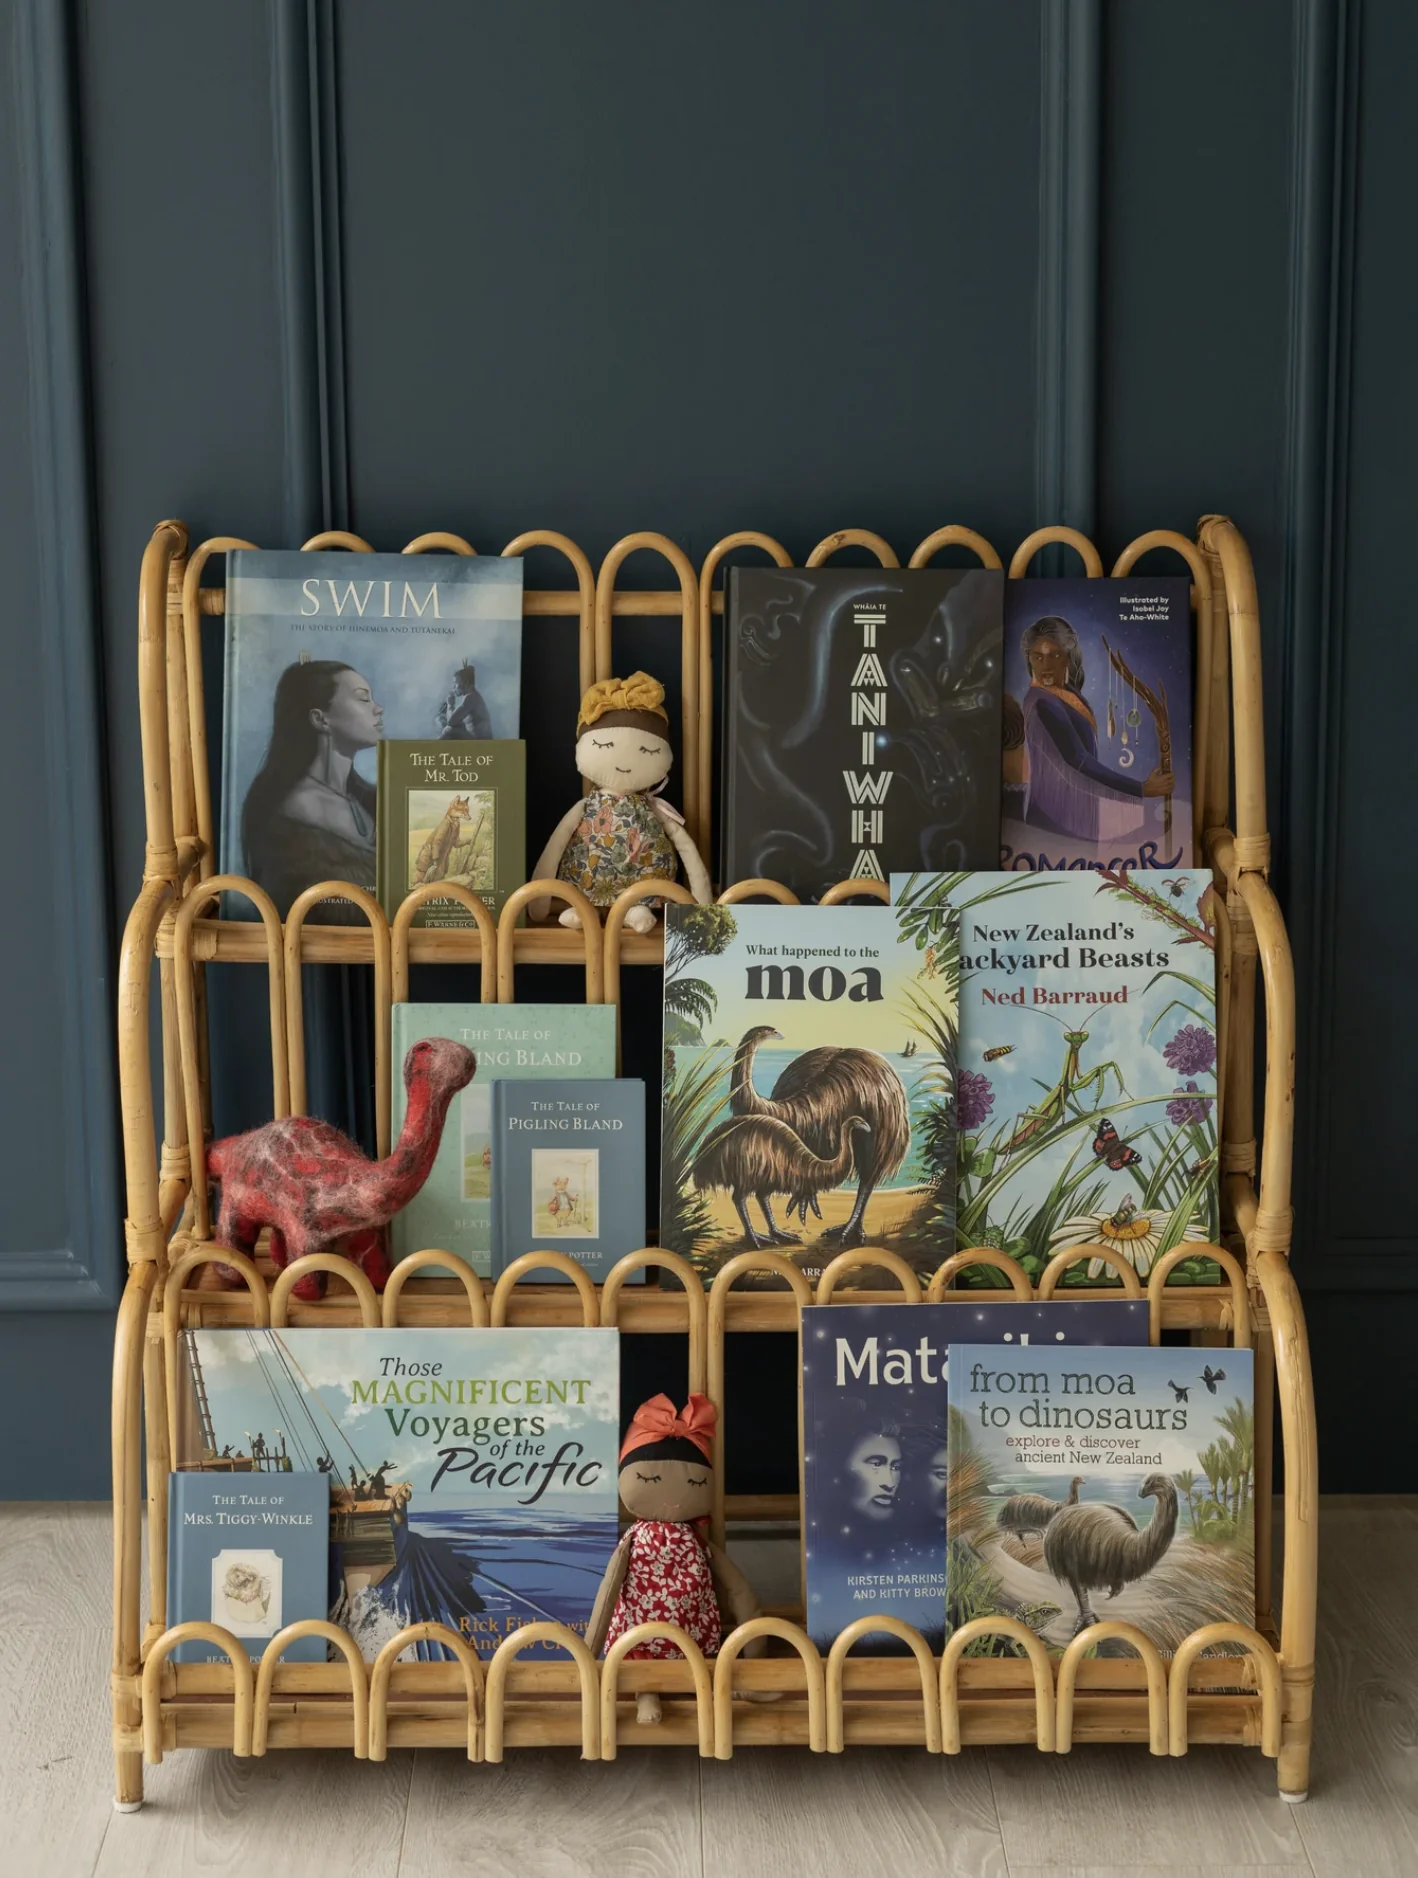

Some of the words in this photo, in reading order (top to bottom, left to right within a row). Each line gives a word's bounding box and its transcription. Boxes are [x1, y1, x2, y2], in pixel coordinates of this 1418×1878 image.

[301, 578, 444, 619] SWIM
[1156, 605, 1169, 613] Joy
[308, 624, 334, 632] STORY
[349, 625, 388, 633] HINEMOA
[843, 614, 893, 882] TANIWHA
[410, 752, 435, 766] THE
[439, 752, 472, 766] TALE
[476, 755, 494, 766] OF
[424, 769, 450, 782] MR.
[452, 769, 479, 782] TOD
[973, 924, 1020, 942] New
[1025, 922, 1135, 941] Zealand’s
[746, 944, 778, 956] What
[781, 945, 841, 959] happened
[844, 947, 857, 957] to
[860, 946, 880, 957] the
[959, 947, 1070, 975] ackyard
[1079, 947, 1170, 968] Beasts
[744, 964, 884, 1002] moa
[981, 986, 1025, 1005] Ned
[1033, 985, 1128, 1005] Barraud
[460, 1028, 489, 1040] THE
[494, 1028, 529, 1040] TALE
[534, 1030, 551, 1040] OF
[516, 1050, 582, 1066] BLAND
[531, 1101, 554, 1111] THE
[557, 1102, 583, 1111] TALE
[586, 1103, 600, 1111] OF
[508, 1117, 569, 1131] PIGLING
[572, 1117, 623, 1131] BLAND
[380, 1357, 443, 1377] Those
[970, 1363, 1050, 1394] from
[1061, 1373, 1136, 1395] moa
[351, 1379, 591, 1404] MAGNIFICENT
[979, 1400, 1011, 1428] to
[1019, 1398, 1188, 1431] dinosaurs
[385, 1408, 546, 1446] Voyagers
[490, 1439, 512, 1460] of
[515, 1440, 546, 1457] the
[1006, 1435, 1060, 1450] explore
[1064, 1435, 1075, 1448] &
[1079, 1435, 1141, 1449] discover
[1015, 1450, 1066, 1464] ancient
[1069, 1451, 1101, 1464] New
[1105, 1452, 1163, 1465] Zealand
[430, 1441, 603, 1505] Pacific
[212, 1494, 237, 1505] THE
[239, 1494, 267, 1505] TALE
[270, 1496, 285, 1505] OF
[184, 1512, 214, 1525] MRS.
[216, 1512, 313, 1525] TIGGY-WINKLE
[847, 1575, 894, 1586] KIRSTEN
[897, 1573, 947, 1584] PARKINS
[853, 1589, 876, 1599] AND
[880, 1588, 911, 1598] KITTY
[914, 1587, 947, 1597] BROW
[459, 1616, 499, 1632] Rick
[207, 1655, 231, 1664] BEAT
